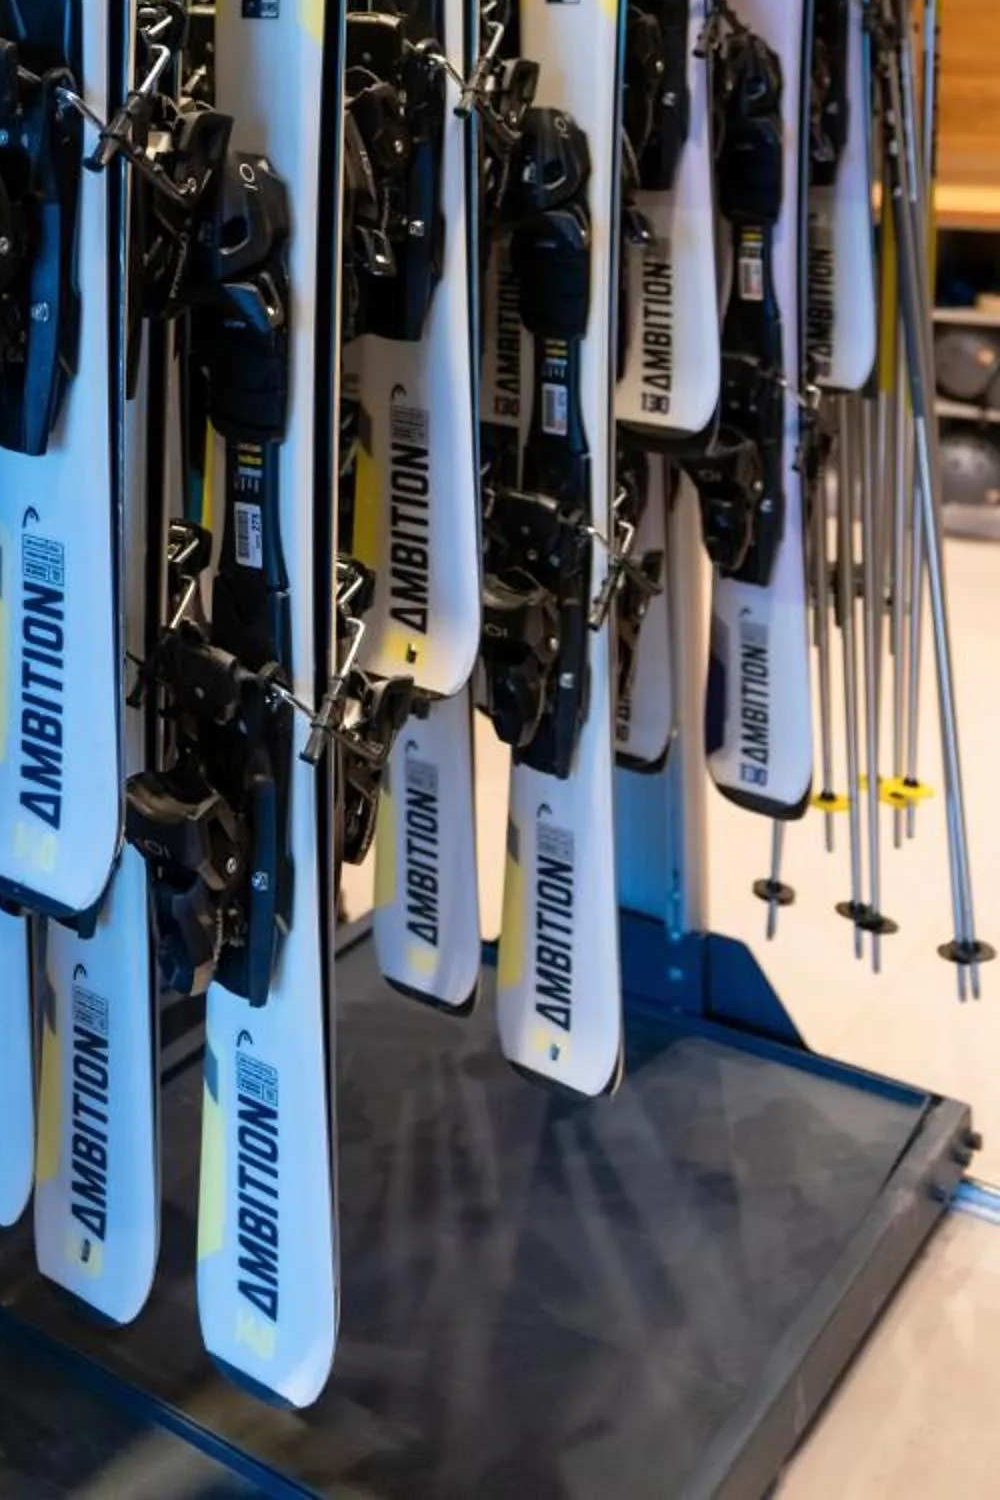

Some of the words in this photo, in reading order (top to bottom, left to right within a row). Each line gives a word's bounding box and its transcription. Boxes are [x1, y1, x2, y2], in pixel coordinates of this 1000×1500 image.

[640, 259, 674, 392] AMBITION
[389, 439, 430, 636] AMBITION
[19, 580, 65, 830] AMBITION
[738, 640, 770, 769] AMBITION
[406, 778, 440, 949] AMBITION
[532, 853, 576, 1033] AMBITION
[71, 1023, 109, 1243] AMBITION
[236, 1095, 279, 1324] AMBITION
